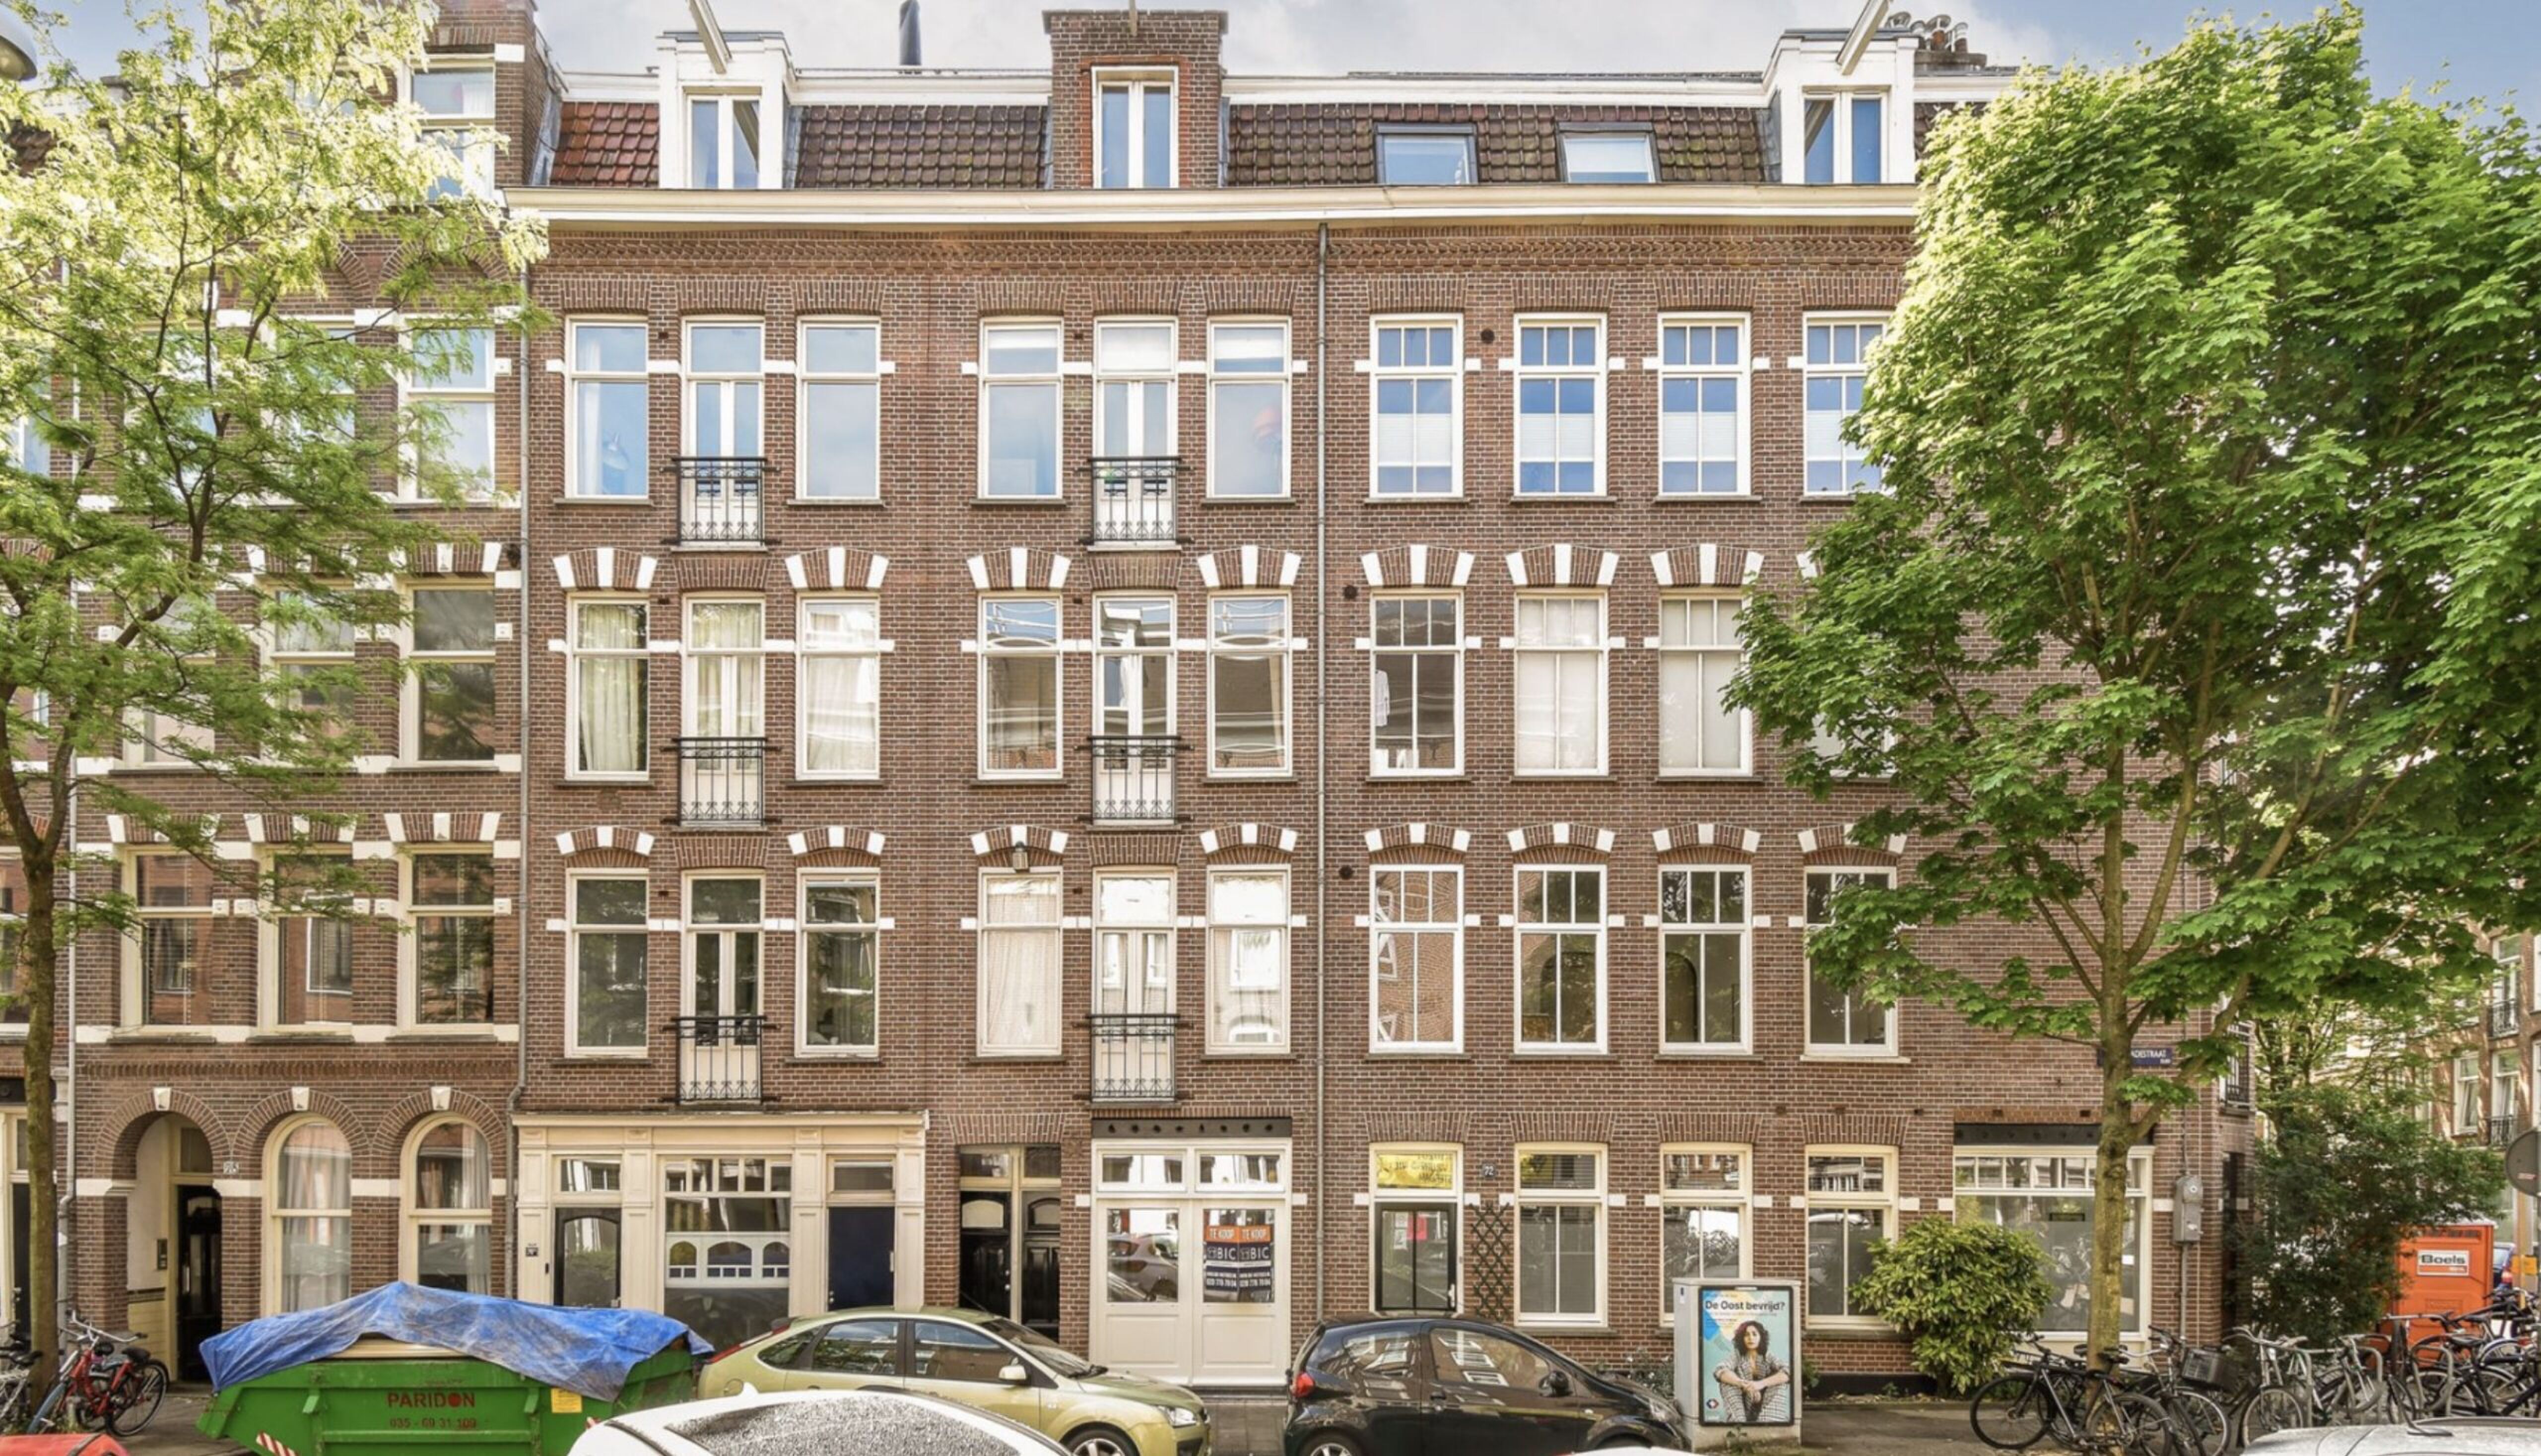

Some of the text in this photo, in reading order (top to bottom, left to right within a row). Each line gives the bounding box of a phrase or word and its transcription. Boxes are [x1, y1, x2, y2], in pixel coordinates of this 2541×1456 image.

[2421, 1255, 2466, 1264] Boels
[1705, 1300, 1786, 1312] De Oost bevrijd?
[388, 1391, 475, 1408] PARIDON
